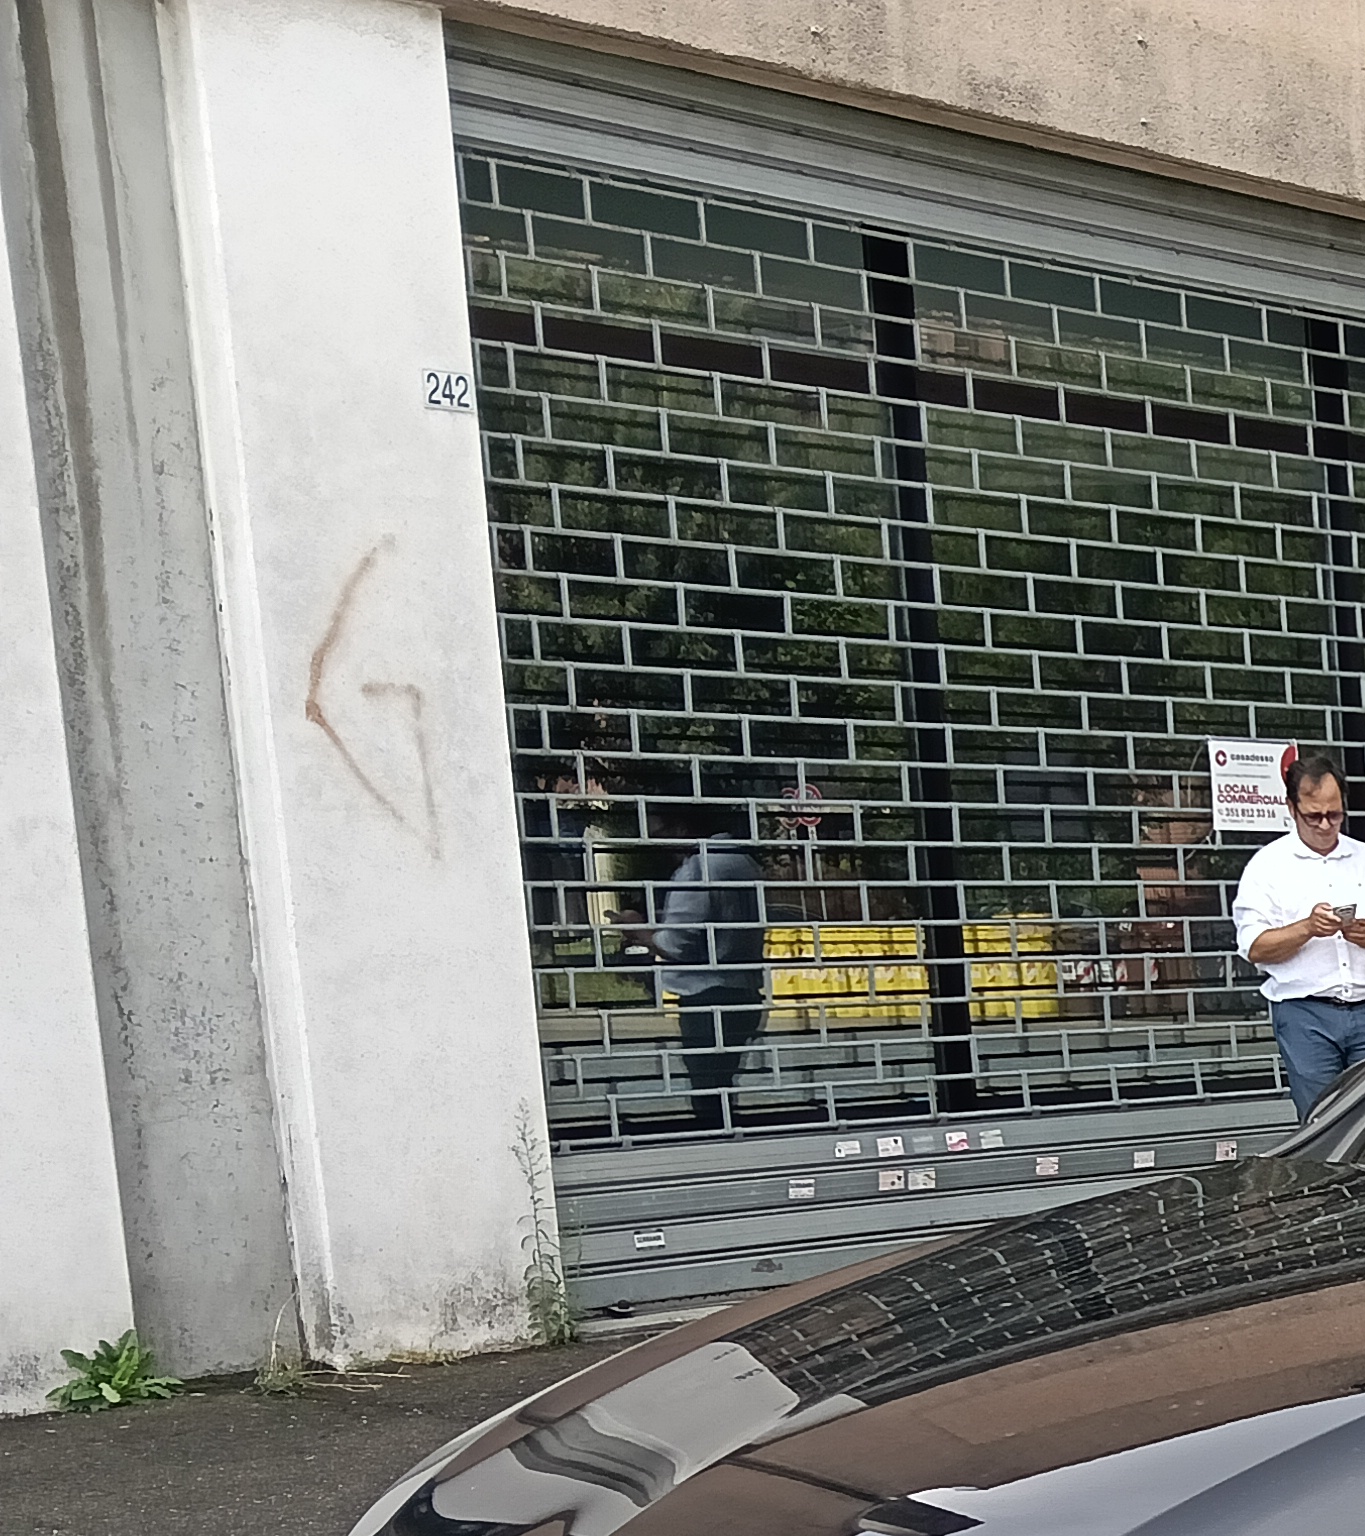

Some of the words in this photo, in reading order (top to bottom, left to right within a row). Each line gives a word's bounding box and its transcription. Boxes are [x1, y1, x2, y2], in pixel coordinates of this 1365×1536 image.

[426, 372, 470, 408] 242
[1217, 783, 1259, 795] LOCALE
[1217, 794, 1288, 806] COMMERCIAL
